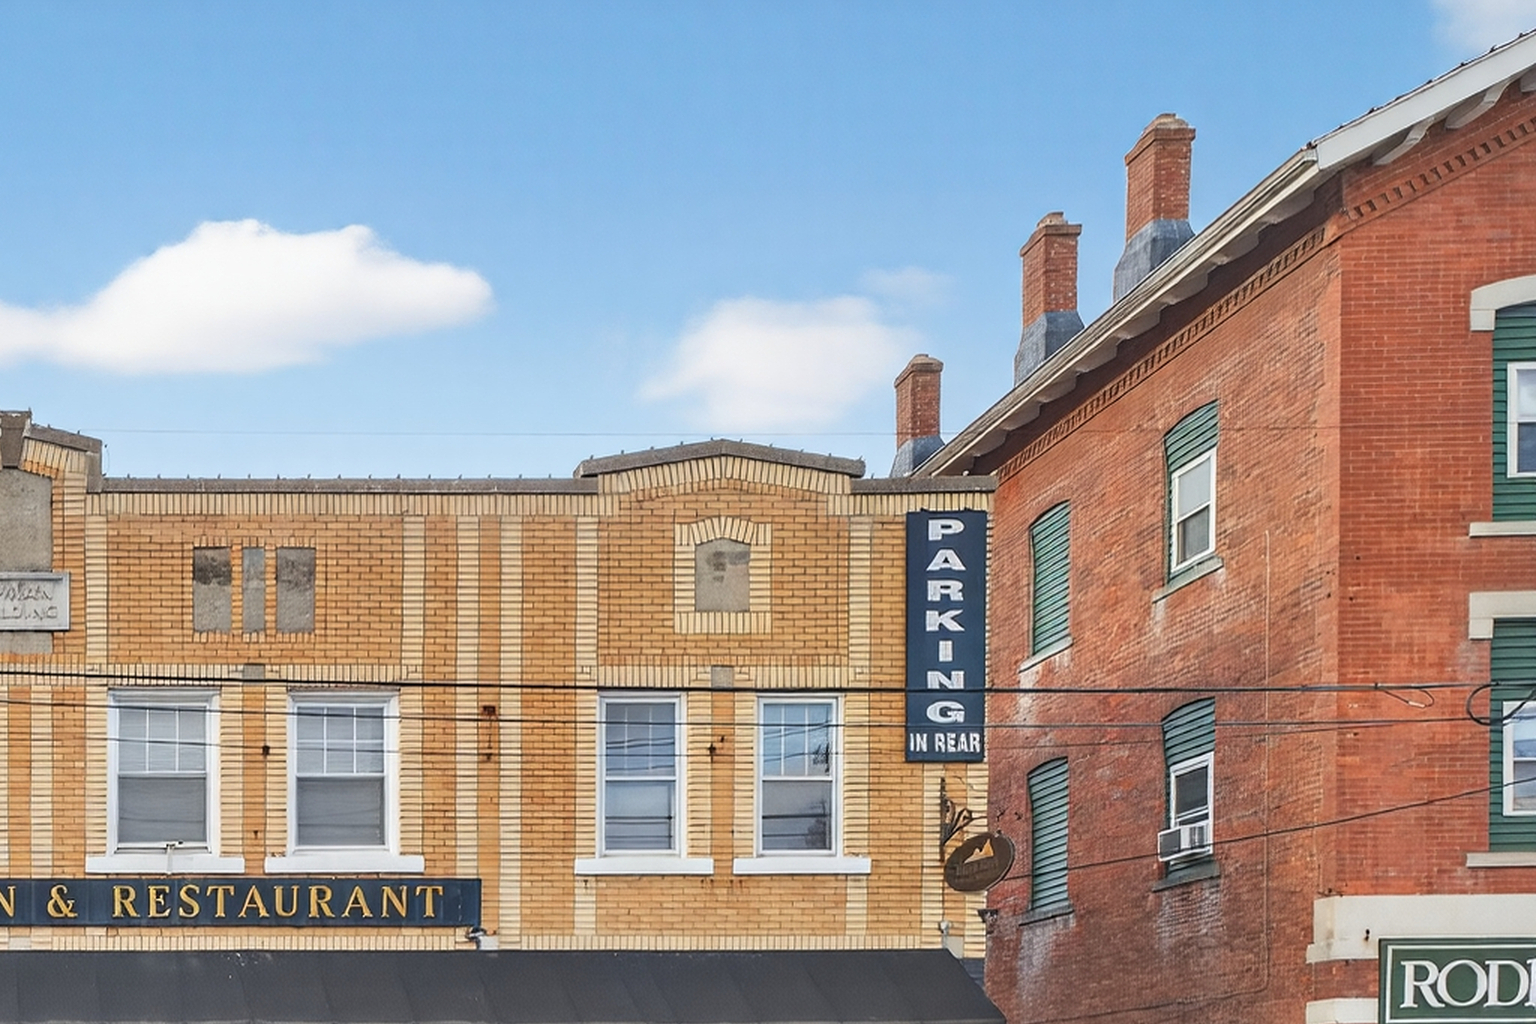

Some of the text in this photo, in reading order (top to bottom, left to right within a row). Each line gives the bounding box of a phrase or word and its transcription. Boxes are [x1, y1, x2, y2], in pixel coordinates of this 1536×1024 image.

[925, 518, 966, 723] PARKING
[910, 733, 981, 752] IN REAR
[46, 885, 78, 918] &
[112, 884, 445, 919] RESTAURANT
